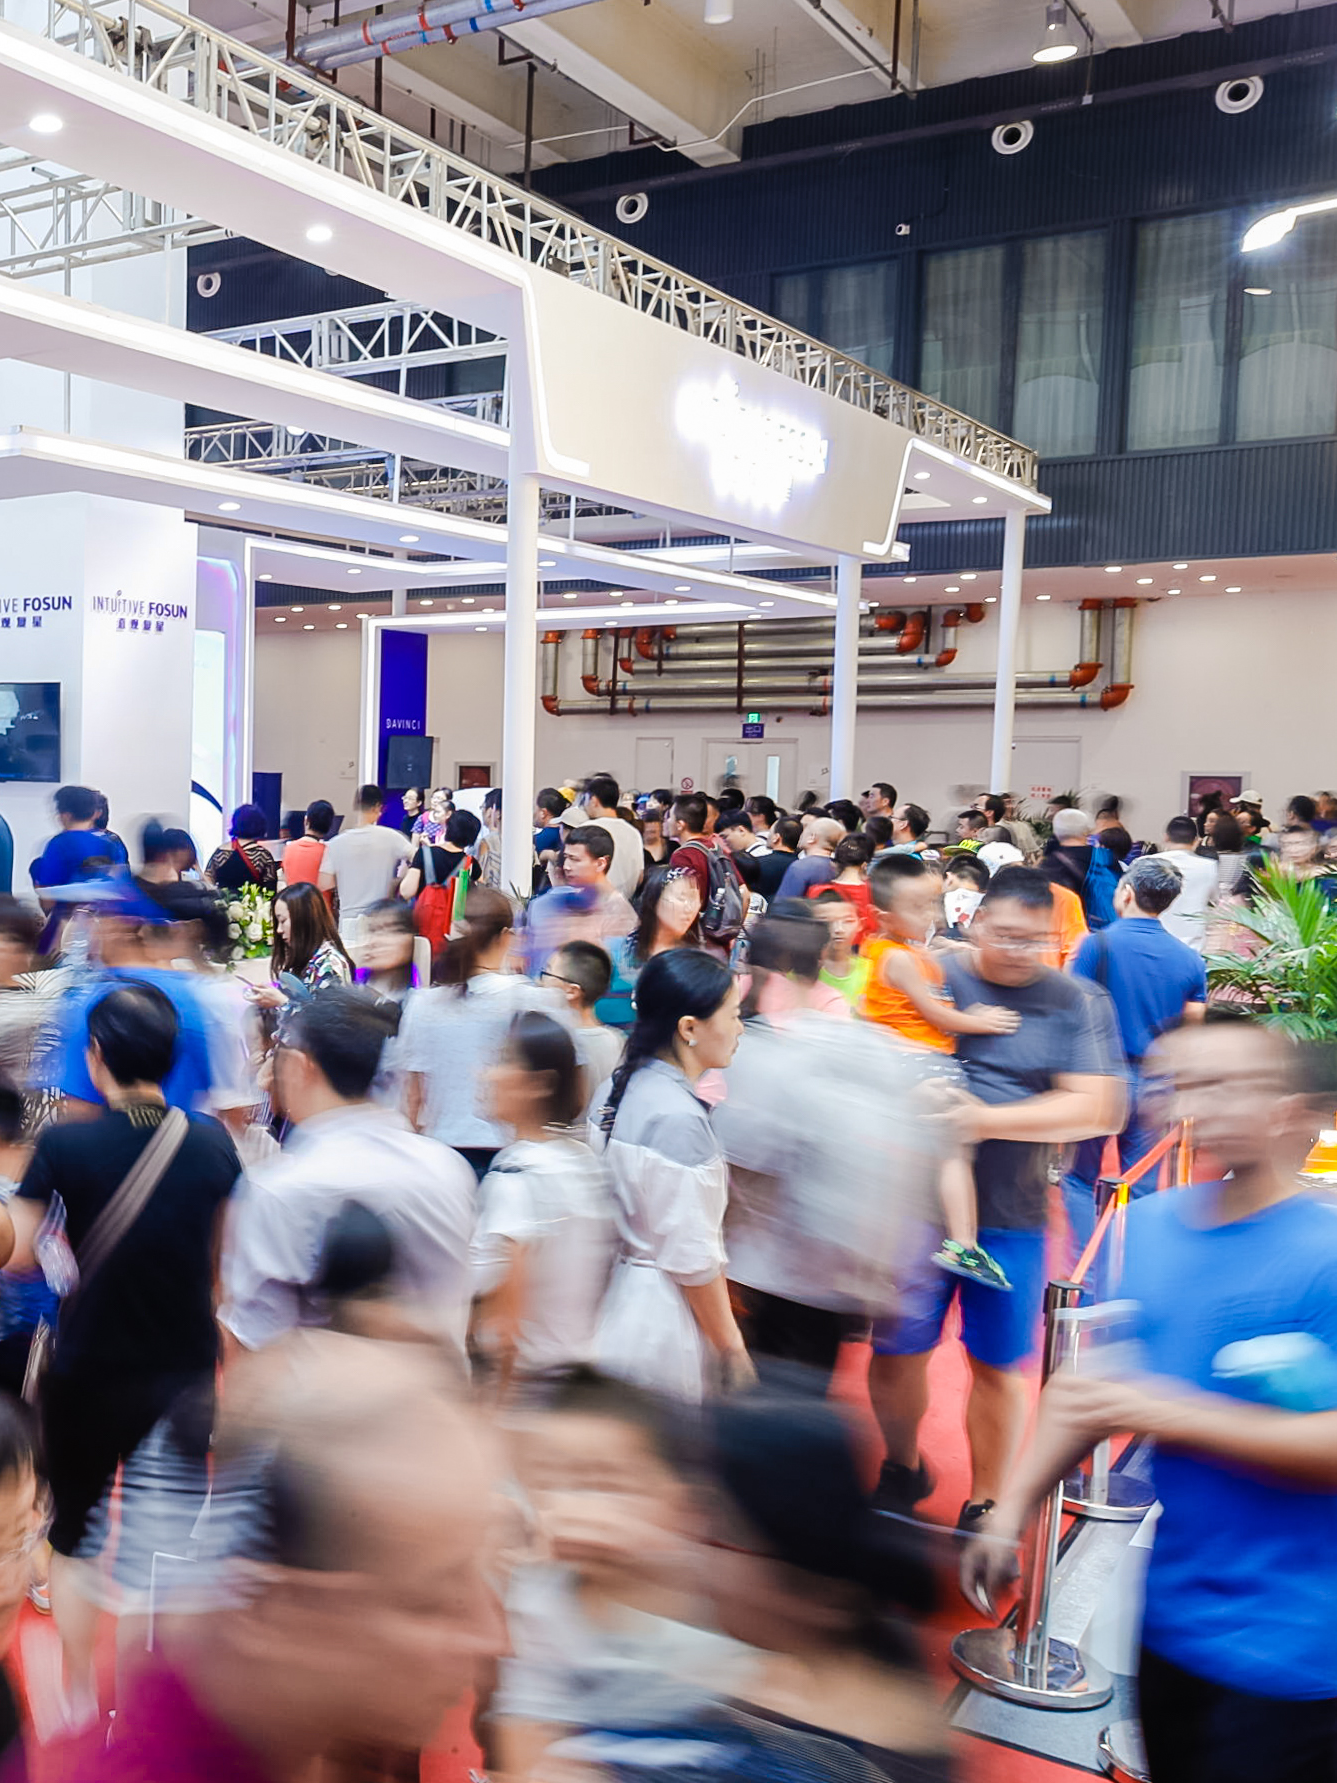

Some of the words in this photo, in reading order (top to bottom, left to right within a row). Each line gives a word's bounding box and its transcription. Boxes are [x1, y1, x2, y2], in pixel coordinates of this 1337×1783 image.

[23, 595, 72, 612] FOSUN
[148, 602, 188, 619] FOSUN
[386, 718, 421, 730] DAVINCI
